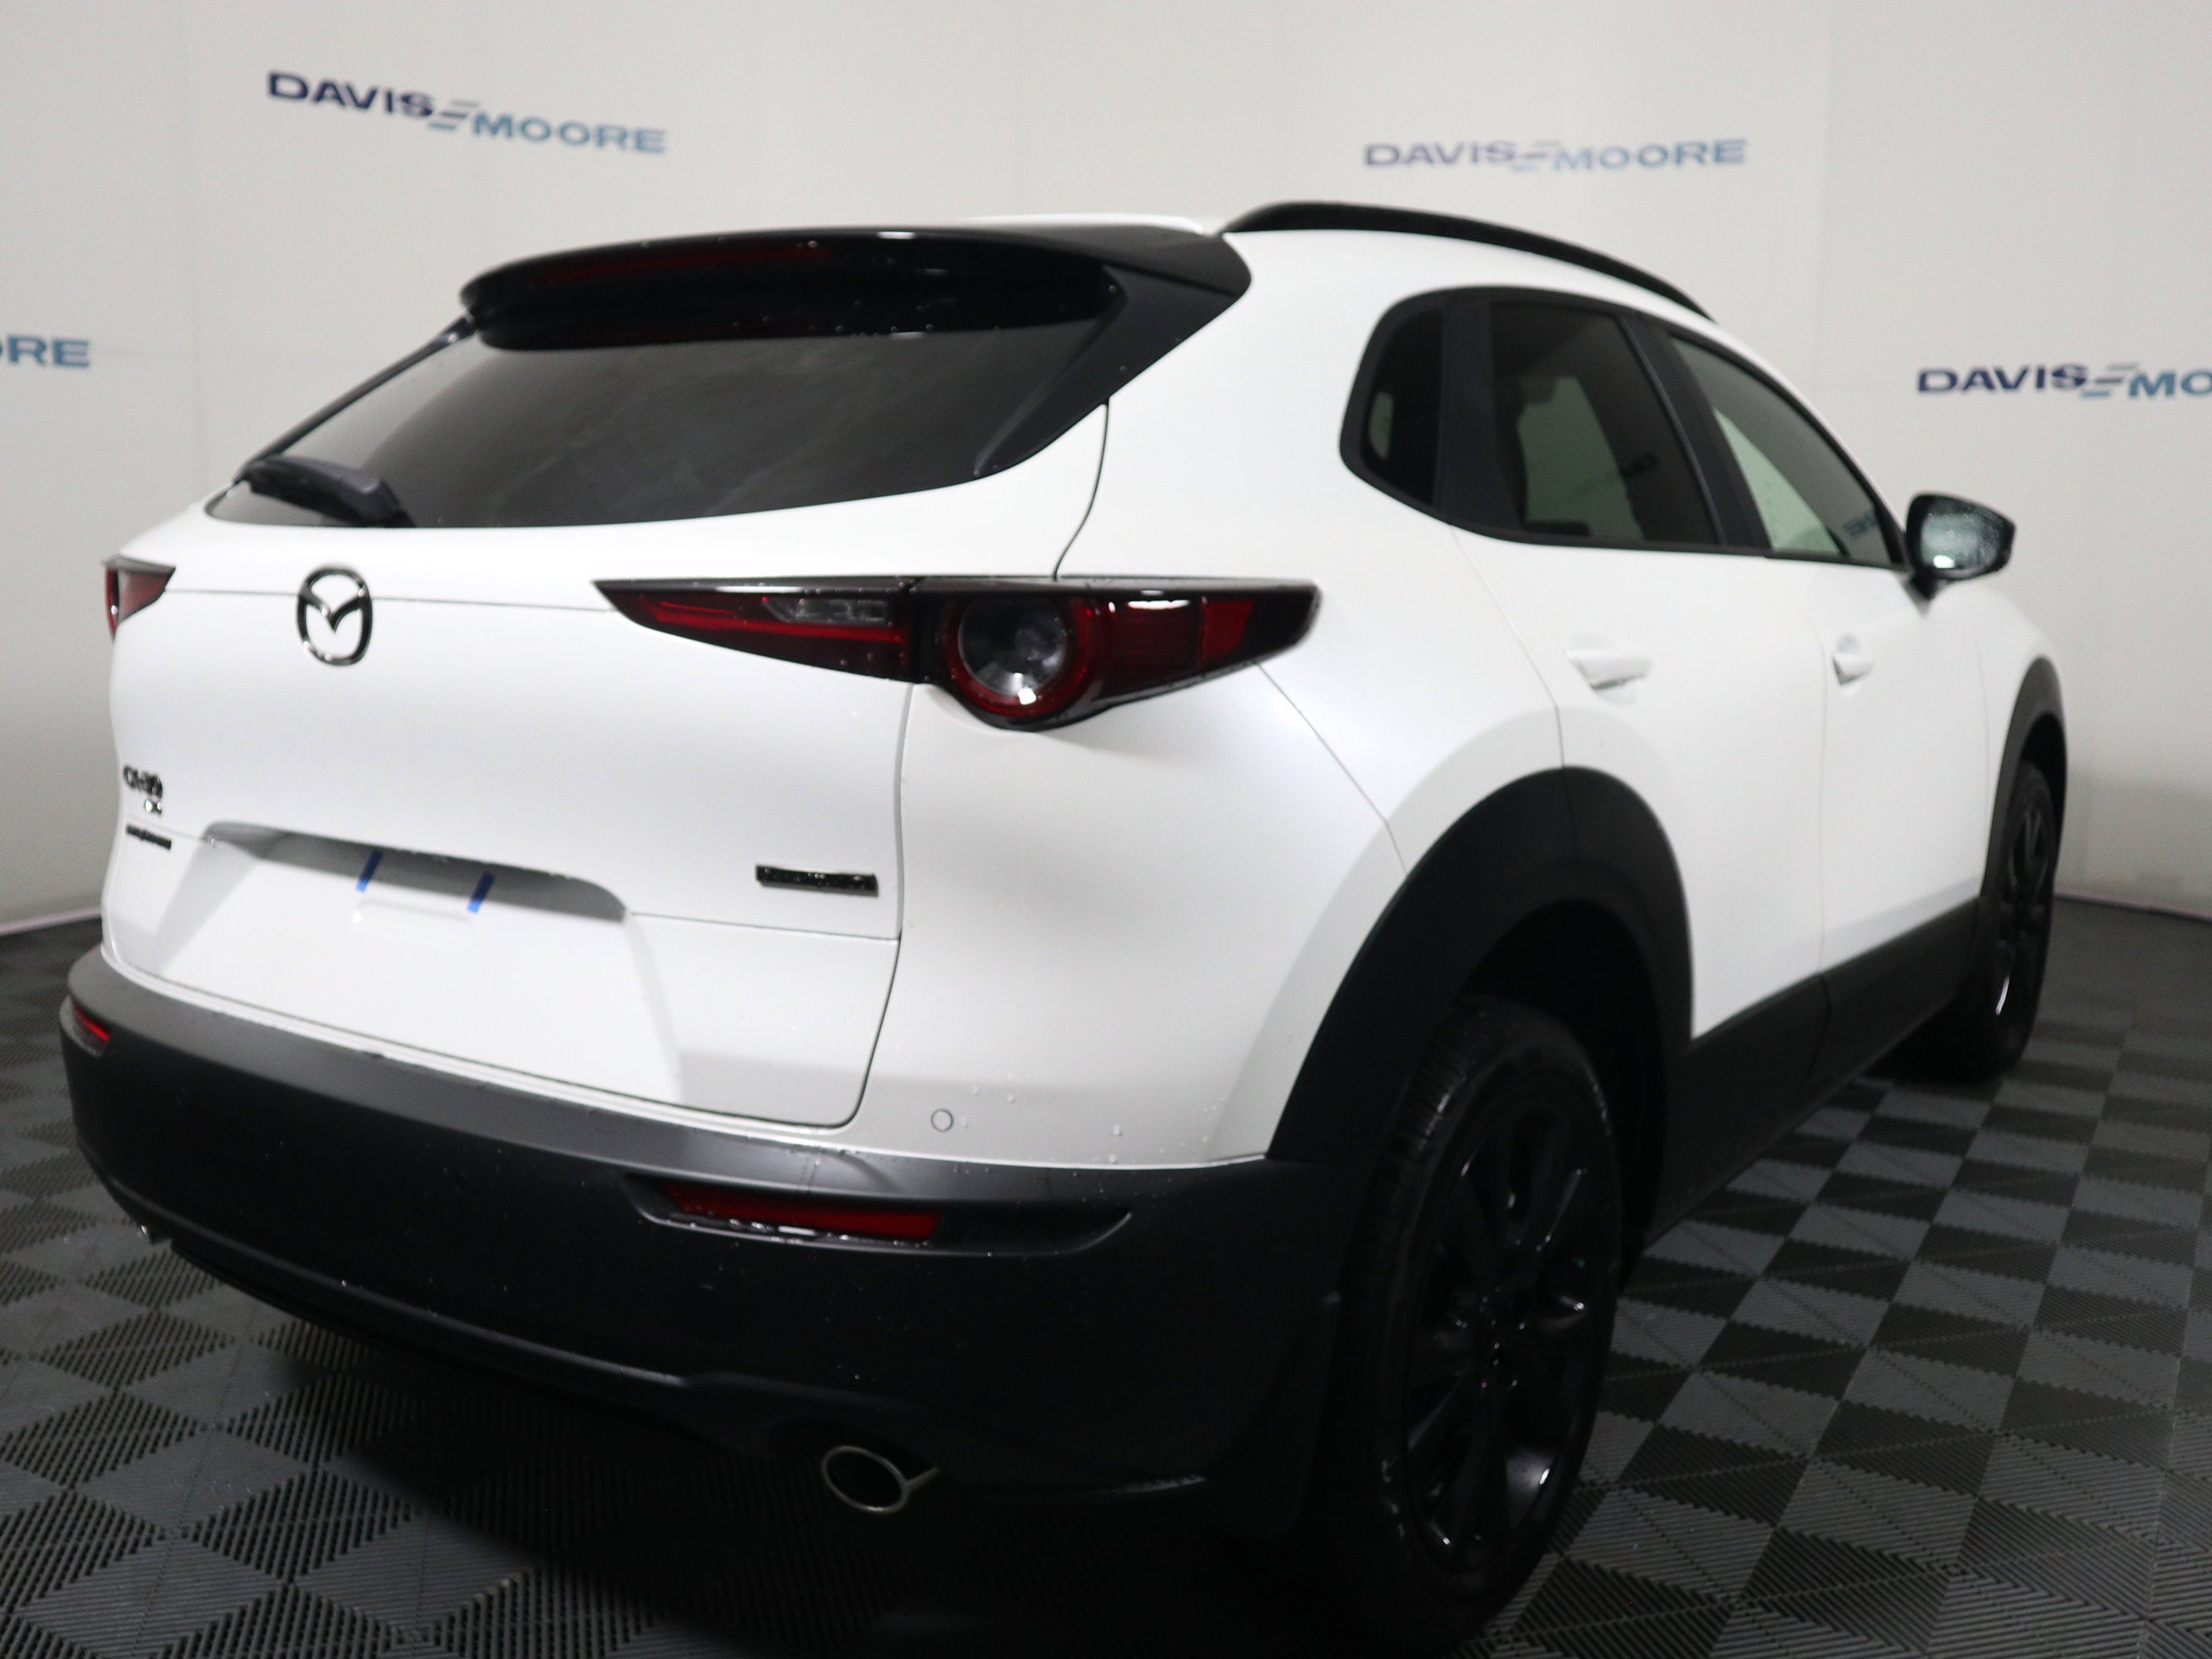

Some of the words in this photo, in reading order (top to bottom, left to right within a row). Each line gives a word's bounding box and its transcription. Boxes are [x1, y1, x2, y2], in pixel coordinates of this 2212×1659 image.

[267, 72, 435, 118] DAVIS
[472, 111, 668, 154] MOORE
[1363, 141, 1518, 167] DAVIS
[1554, 138, 1747, 172] MOORE
[0, 336, 90, 367] RE
[1917, 364, 2088, 393] DAVIS
